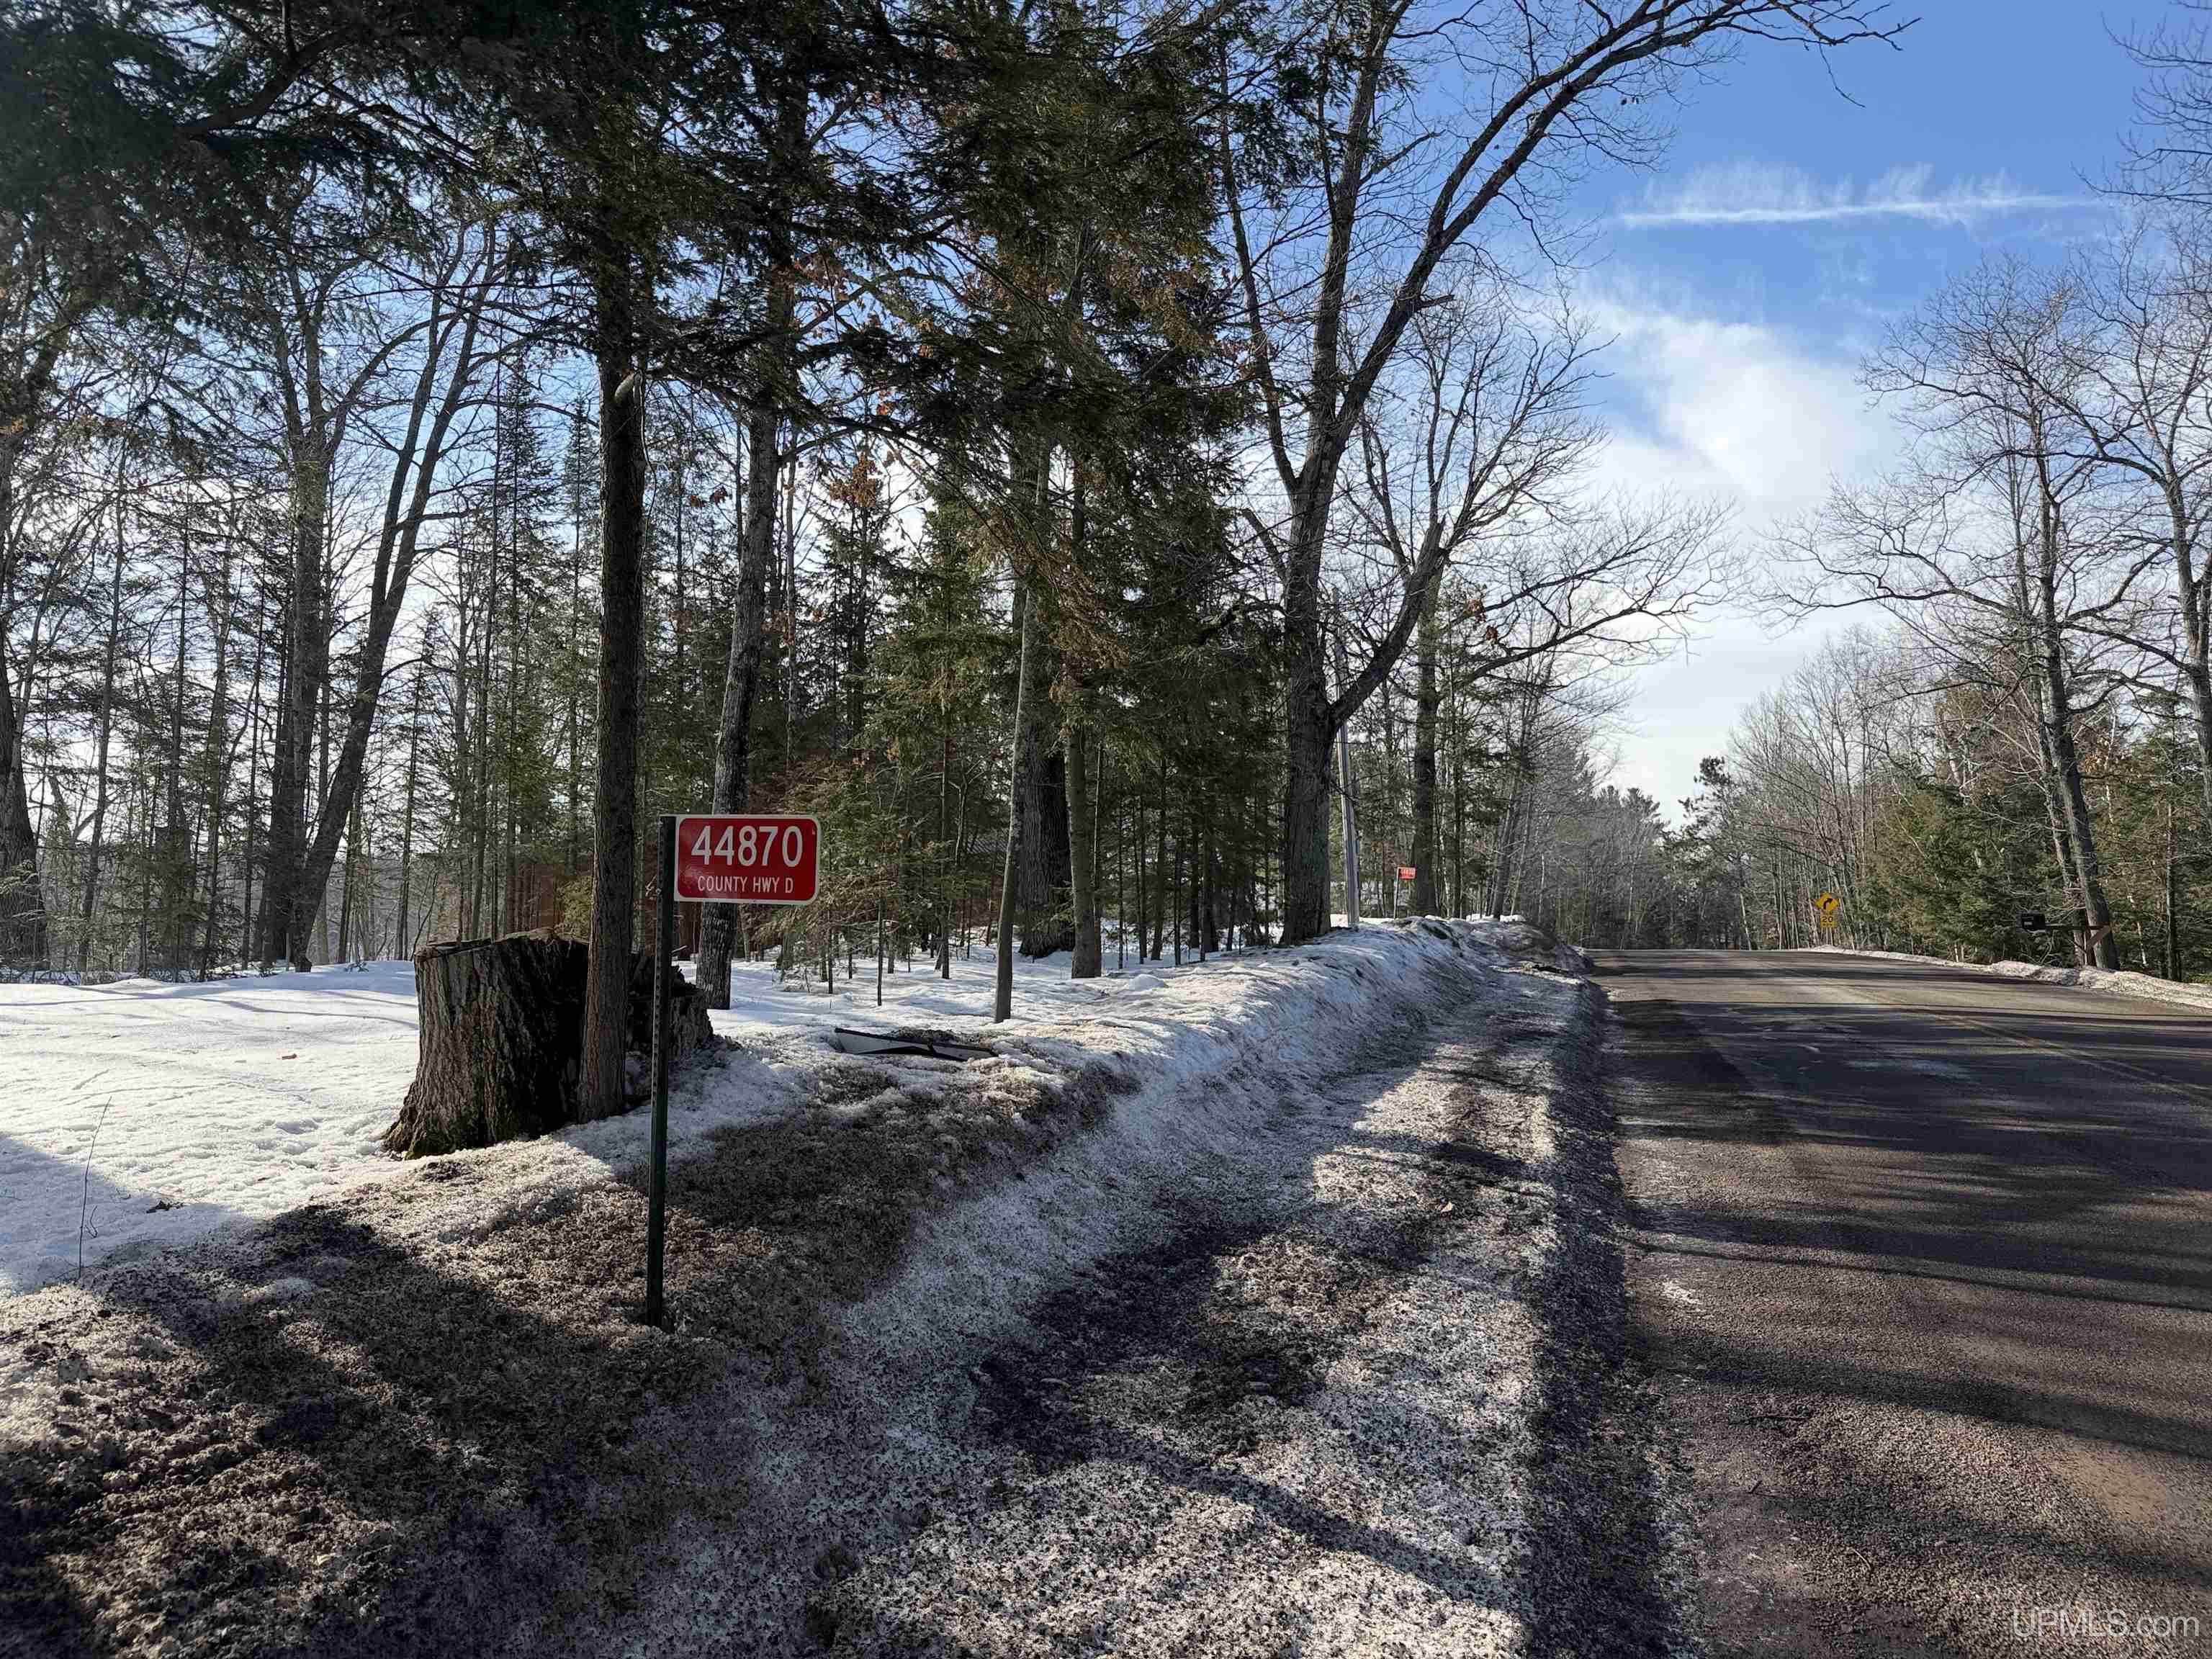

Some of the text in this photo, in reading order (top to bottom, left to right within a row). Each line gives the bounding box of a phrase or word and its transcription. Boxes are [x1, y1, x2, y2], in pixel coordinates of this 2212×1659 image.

[691, 825, 803, 867] 44870
[697, 876, 793, 894] COUNTY HWY D
